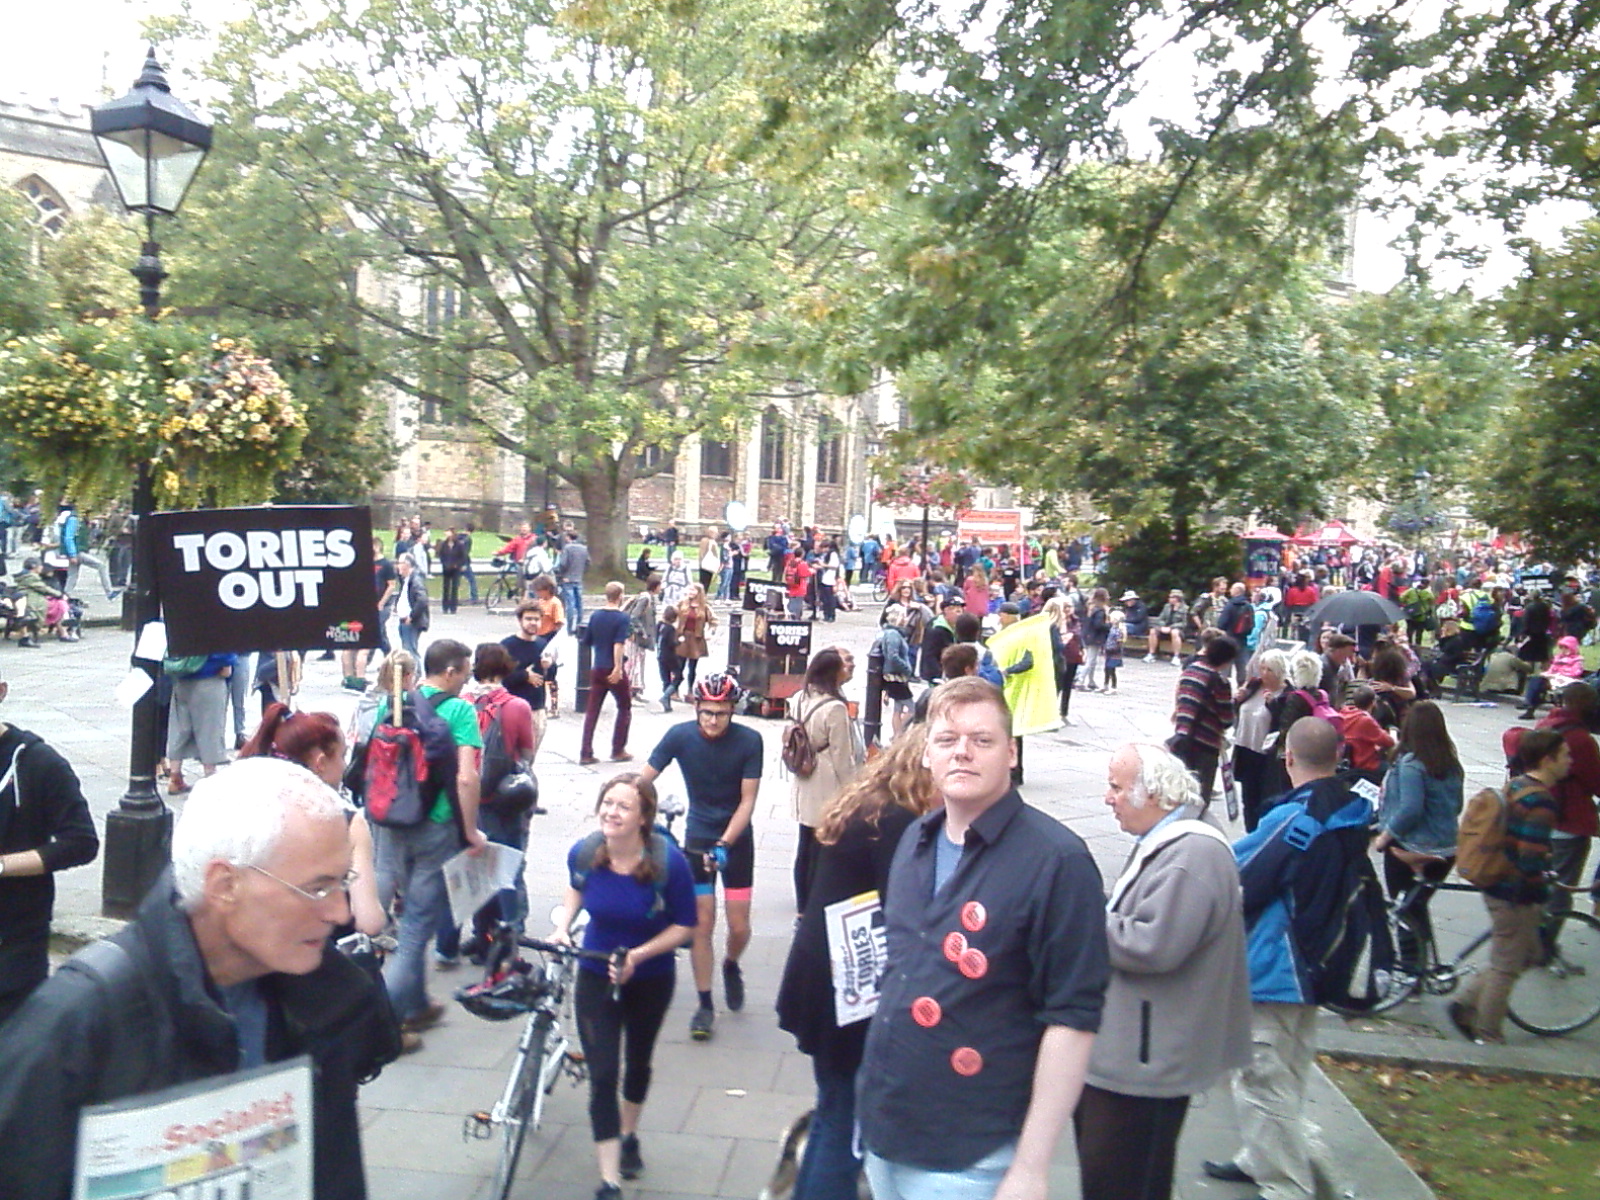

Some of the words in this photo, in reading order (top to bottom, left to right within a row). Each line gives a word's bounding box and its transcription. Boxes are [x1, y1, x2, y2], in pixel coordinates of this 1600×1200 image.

[173, 529, 356, 572] TORIES
[218, 570, 324, 610] OUT
[770, 625, 809, 636] TORIES
[777, 636, 801, 645] OUT
[851, 926, 874, 991] TORIES
